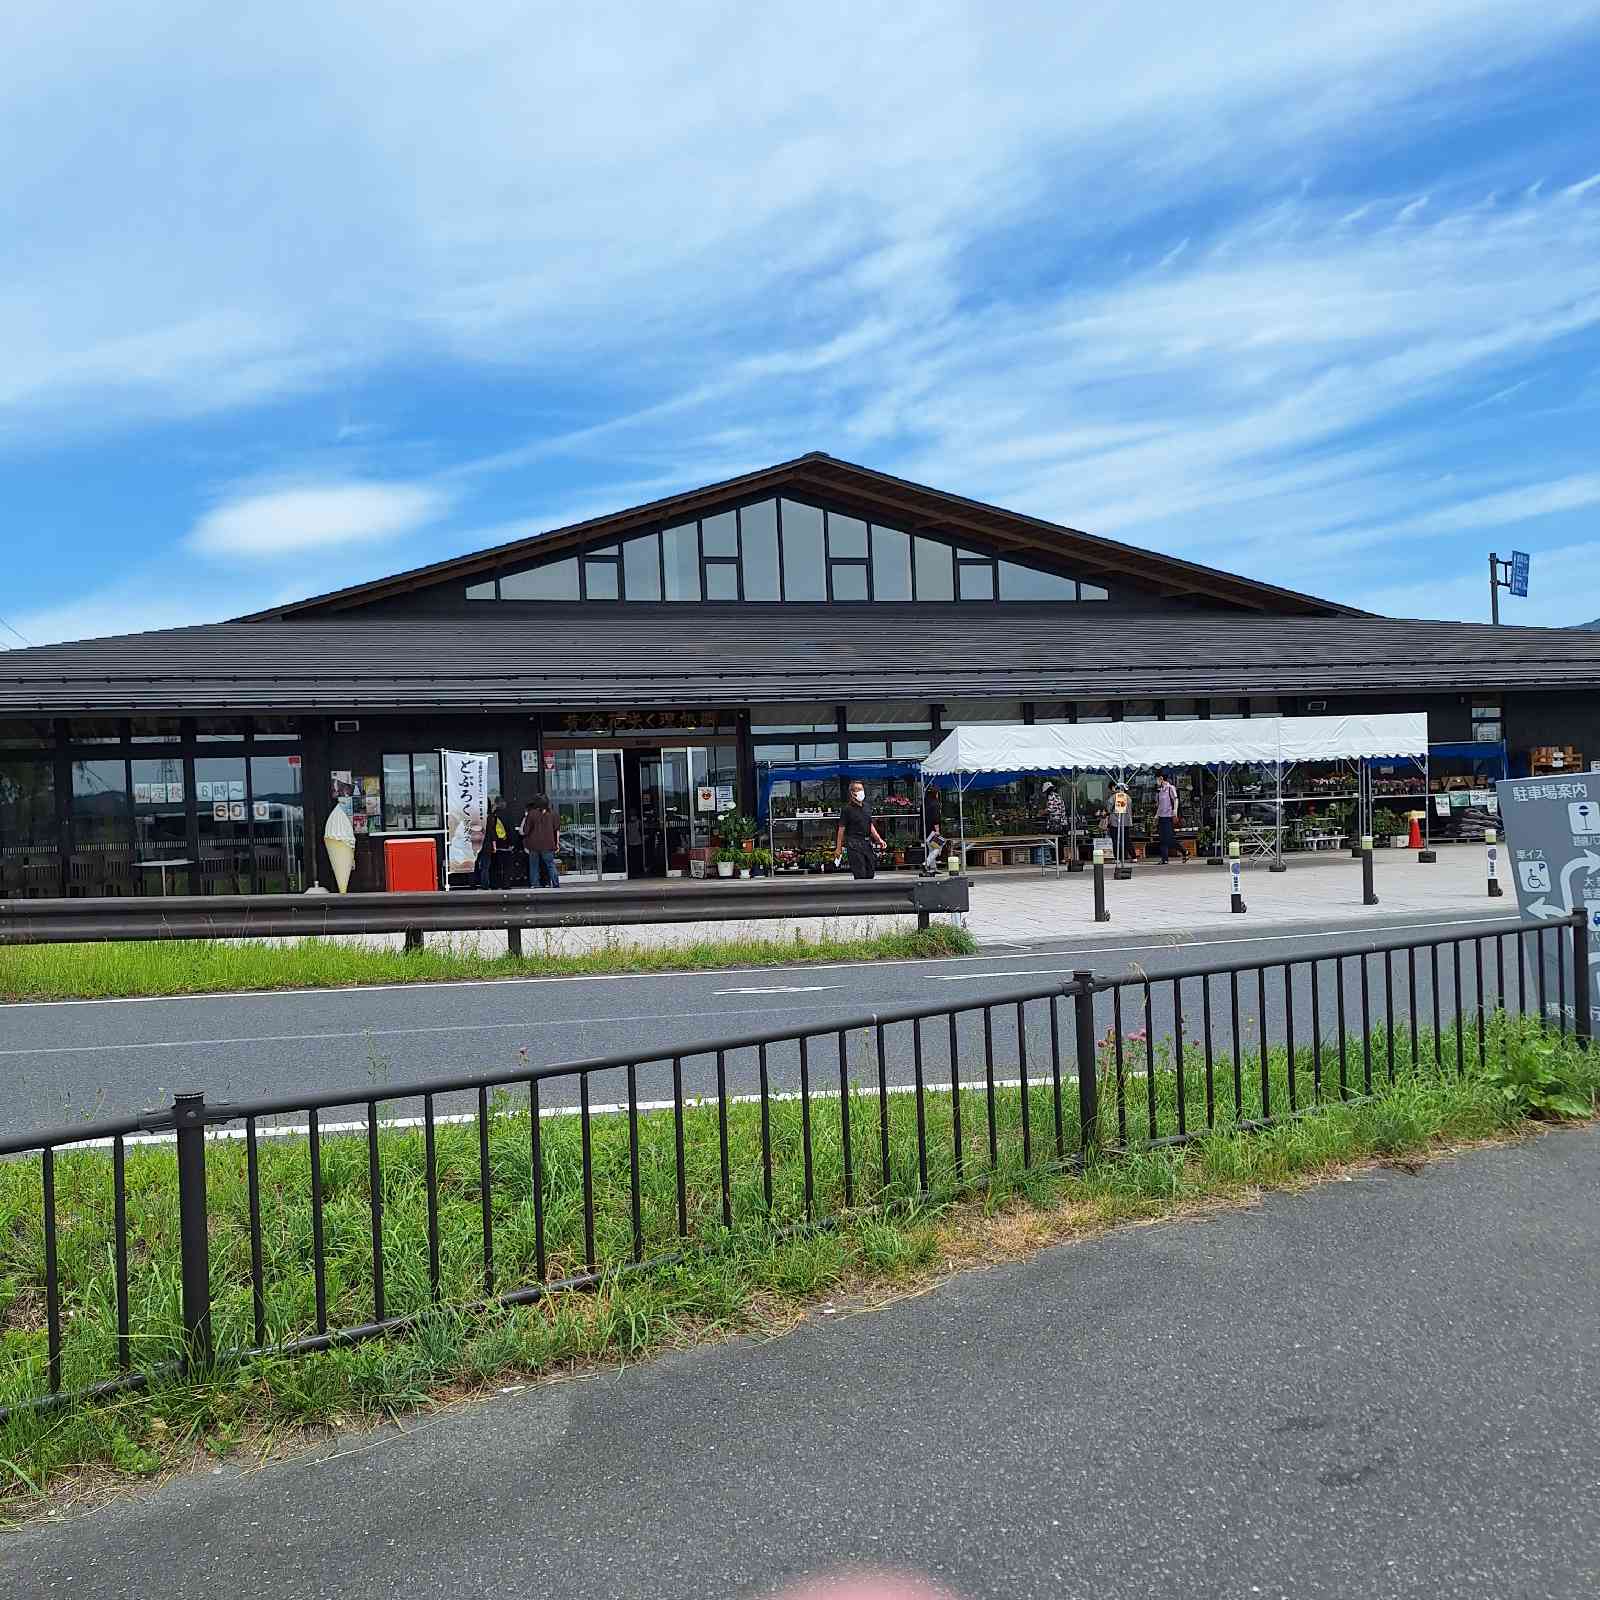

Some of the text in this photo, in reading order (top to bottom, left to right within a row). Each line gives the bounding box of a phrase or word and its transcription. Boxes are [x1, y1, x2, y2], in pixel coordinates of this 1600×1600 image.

[1512, 783, 1588, 802] 駐車場案内
[1516, 849, 1545, 860] 車イス
